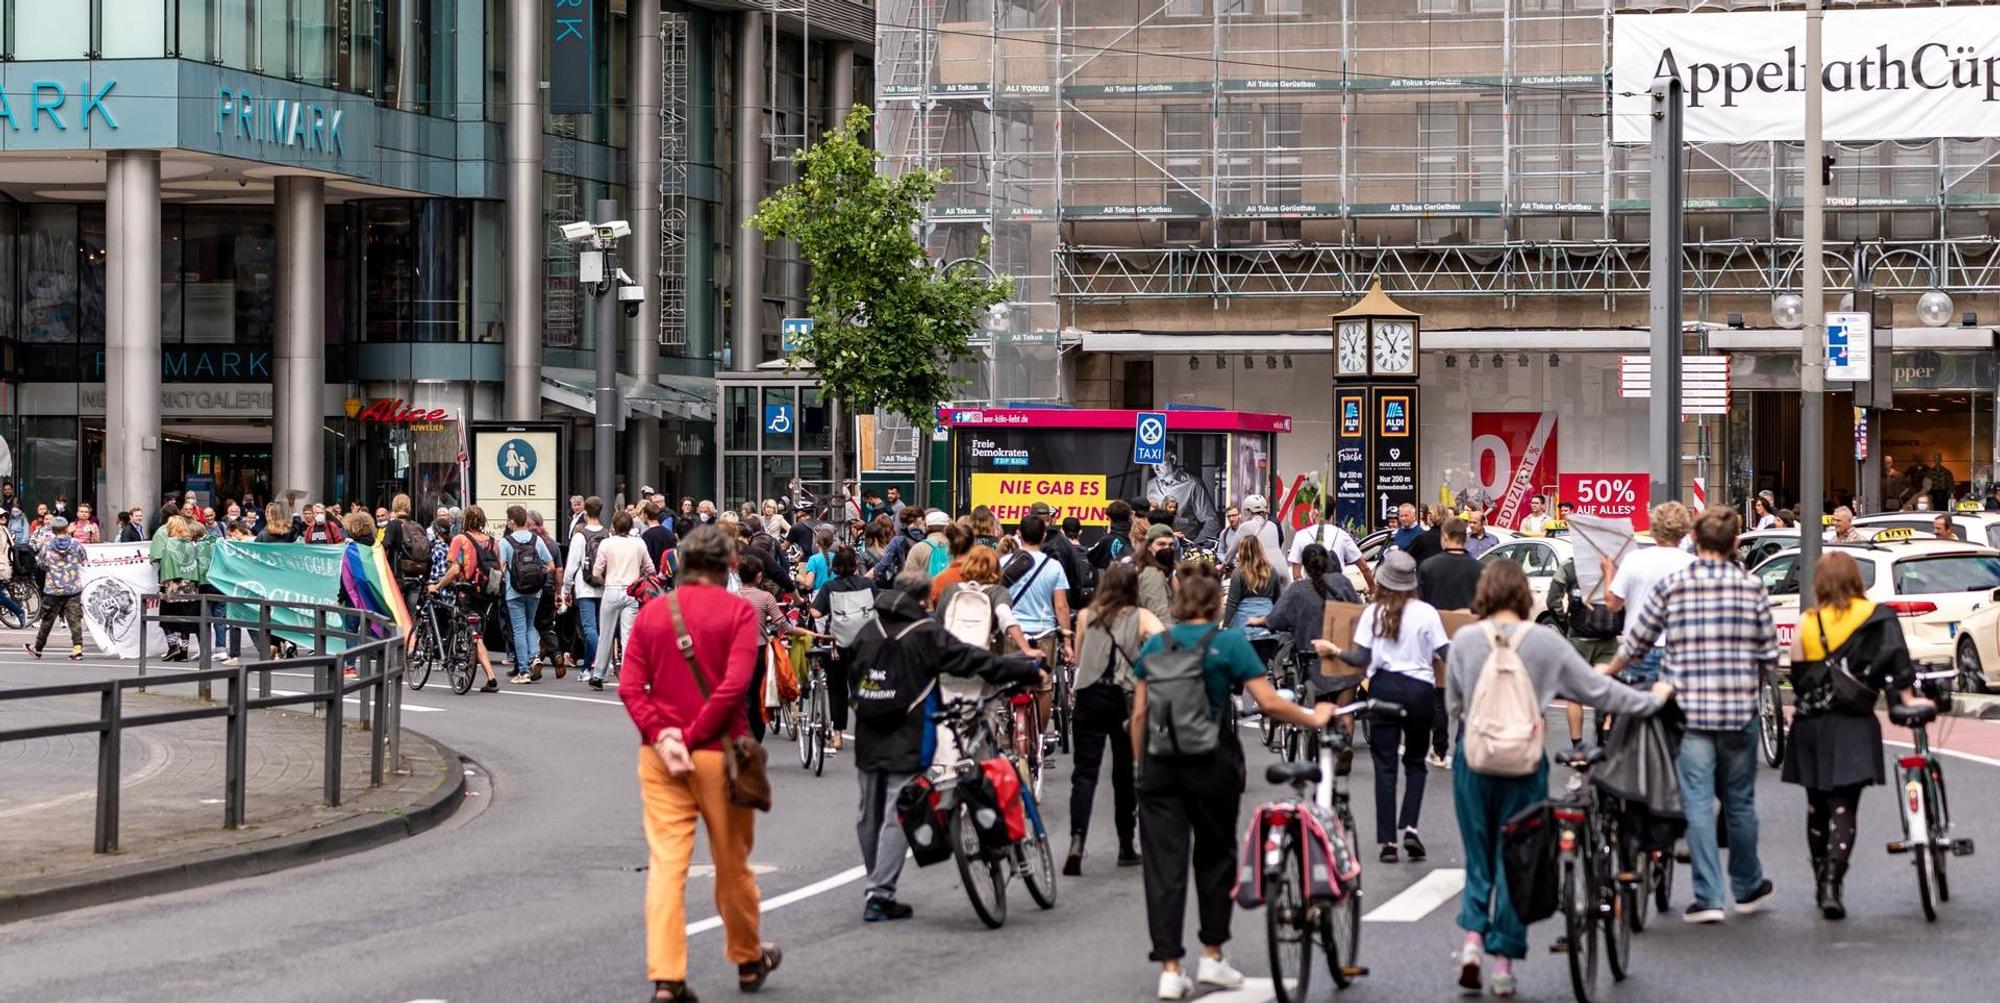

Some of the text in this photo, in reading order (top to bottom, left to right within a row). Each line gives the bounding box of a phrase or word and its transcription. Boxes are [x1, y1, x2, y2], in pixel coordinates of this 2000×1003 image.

[1279, 80, 1316, 88] Gerüstbau
[1391, 79, 1401, 87] Ali
[1401, 79, 1424, 87] Tokus
[1532, 76, 1554, 84] Tokus
[1555, 75, 1593, 83] Gerüstbau
[1104, 85, 1114, 93] Ali
[1136, 84, 1173, 92] Gerüstbau
[215, 86, 345, 154] PRIMARK
[1825, 197, 1858, 206] TOKUS
[1103, 206, 1114, 214] Ali
[1114, 206, 1136, 214] Tokus
[1279, 204, 1316, 212] Gerüstbau
[1423, 203, 1461, 211] Gerüstbau
[1554, 202, 1592, 211] Gerüstbau
[359, 397, 448, 423] Alice
[1344, 418, 1359, 427] ALDI
[1386, 418, 1405, 427] ALDI
[410, 424, 444, 432] JUWELIER
[972, 439, 995, 448] Freie
[972, 448, 1029, 457] Demokraten
[1138, 447, 1162, 460] TAXI
[1380, 475, 1391, 483] Nur
[1392, 475, 1403, 483] 200
[500, 484, 537, 497] ZONE
[1000, 480, 1100, 496] NIE GAB ES
[1577, 479, 1636, 504] 50%
[1577, 505, 1600, 515] AUF
